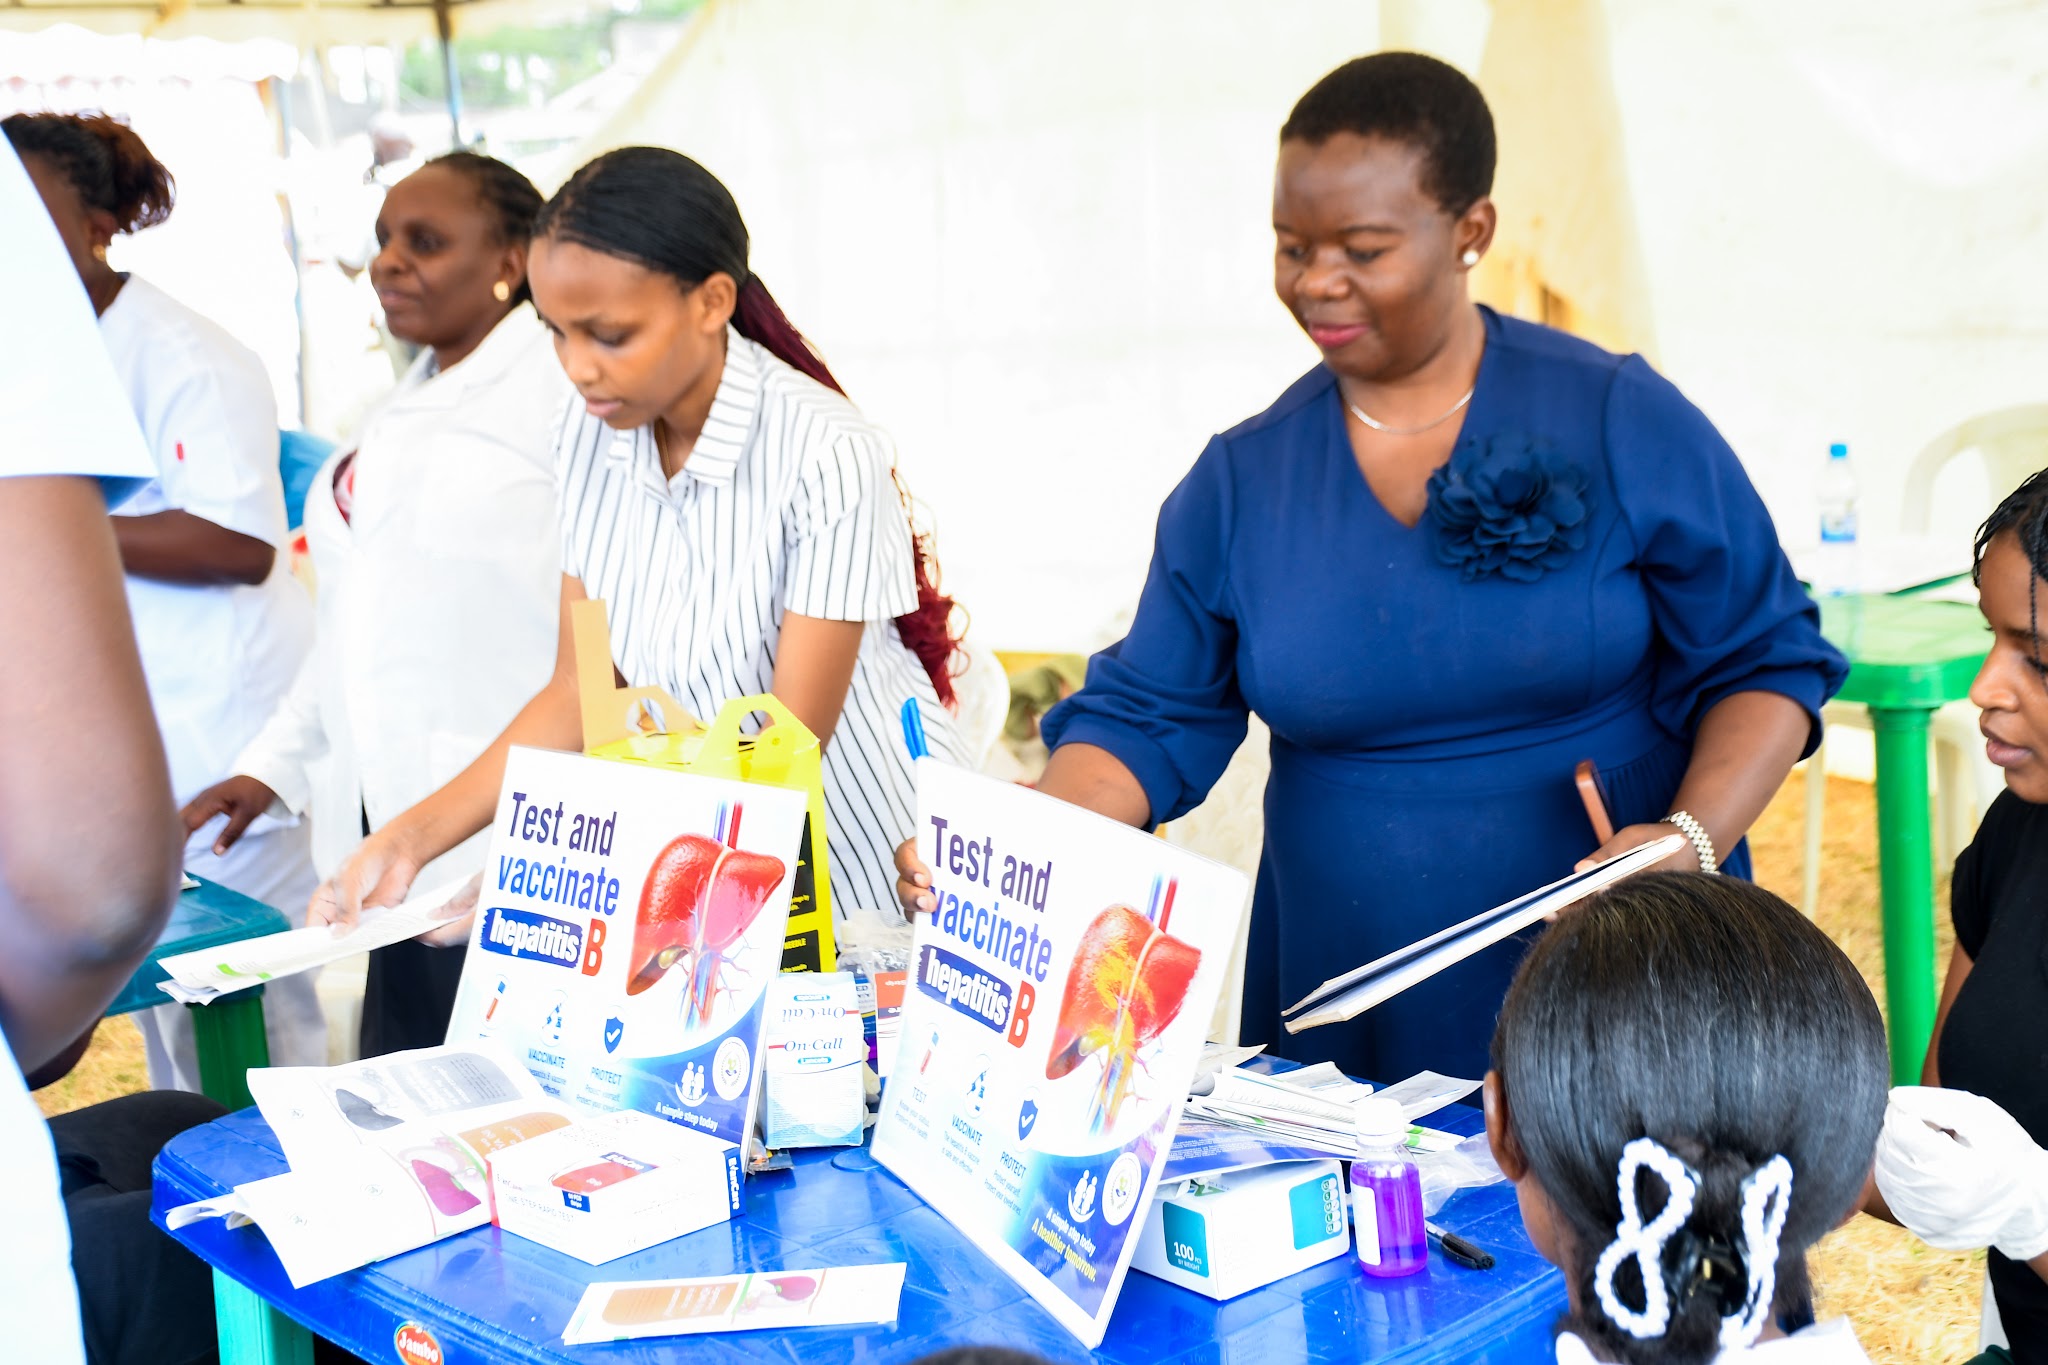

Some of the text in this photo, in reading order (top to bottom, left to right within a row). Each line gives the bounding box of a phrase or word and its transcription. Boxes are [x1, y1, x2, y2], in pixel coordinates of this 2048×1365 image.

[509, 791, 617, 857] Test and
[498, 854, 620, 916] vaccinate
[931, 815, 1052, 913] Test and
[489, 908, 580, 963] hepatitis
[581, 918, 607, 977] B
[928, 885, 1052, 983] vaccinate
[925, 947, 1010, 1026] hepatitis
[1007, 980, 1036, 1049] B
[528, 1047, 566, 1069] VACCINATE
[591, 1066, 622, 1087] PROTECT
[655, 1100, 719, 1133] A simple step today
[912, 1086, 927, 1104] TEST
[951, 1113, 982, 1147] VACCINATE
[999, 1150, 1027, 1180] PROTECT
[1031, 1217, 1097, 1282] A healthier tomorrow.
[1045, 1207, 1097, 1258] A simple step today
[1174, 1241, 1195, 1262] 100
[399, 1331, 439, 1363] Jambo
